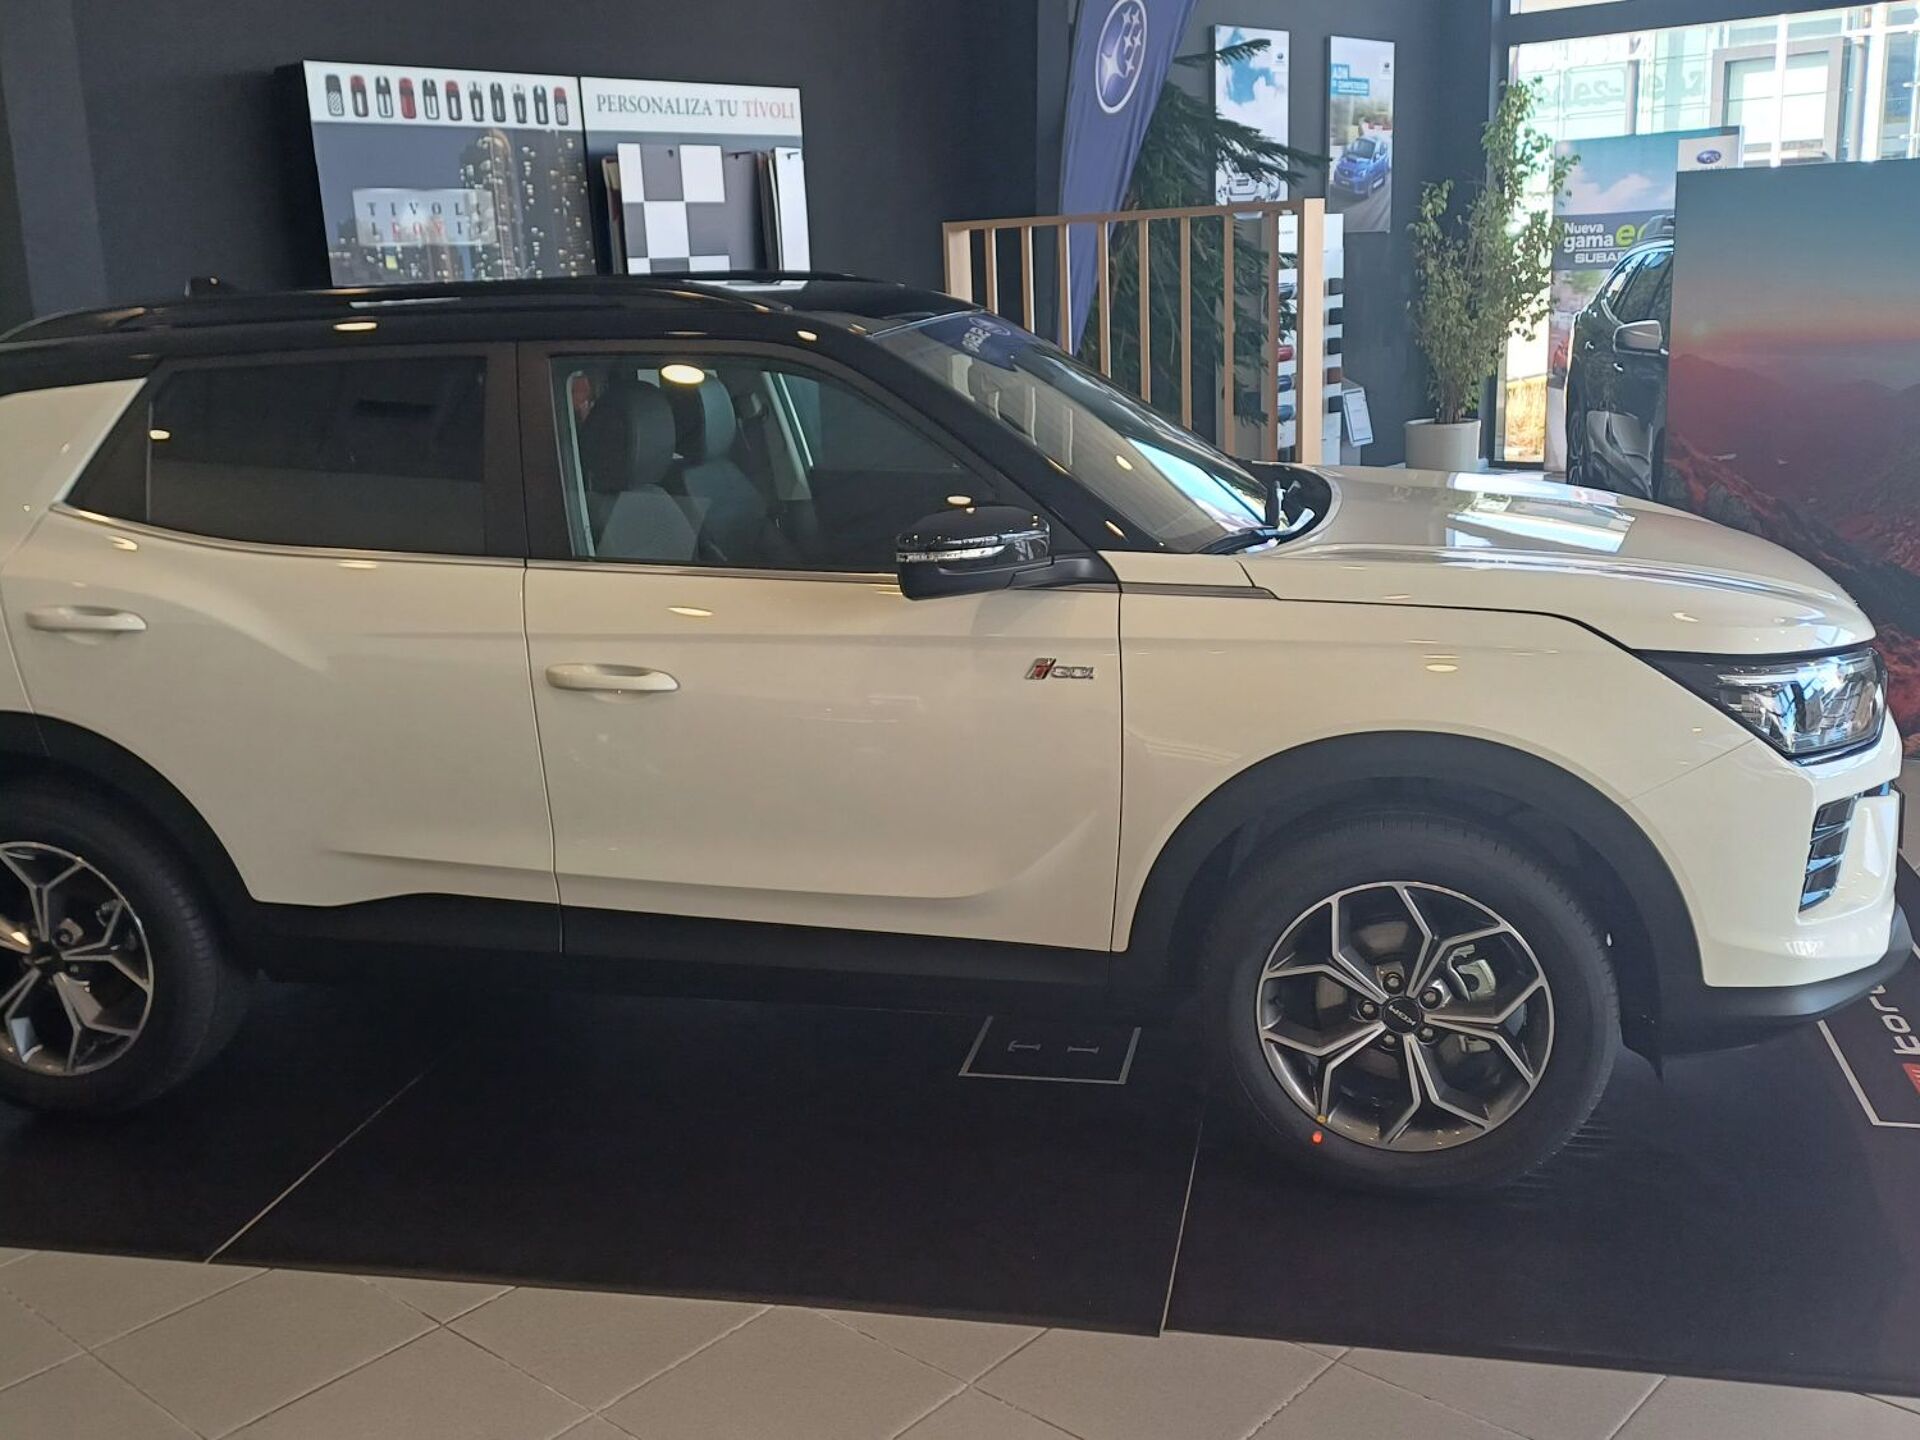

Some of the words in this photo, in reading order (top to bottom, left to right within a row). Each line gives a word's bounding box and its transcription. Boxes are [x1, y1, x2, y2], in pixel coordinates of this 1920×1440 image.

[596, 93, 713, 117] PERSONALIZA
[716, 98, 738, 117] TU
[1564, 222, 1605, 234] Nueva
[1563, 233, 1614, 253] gama
